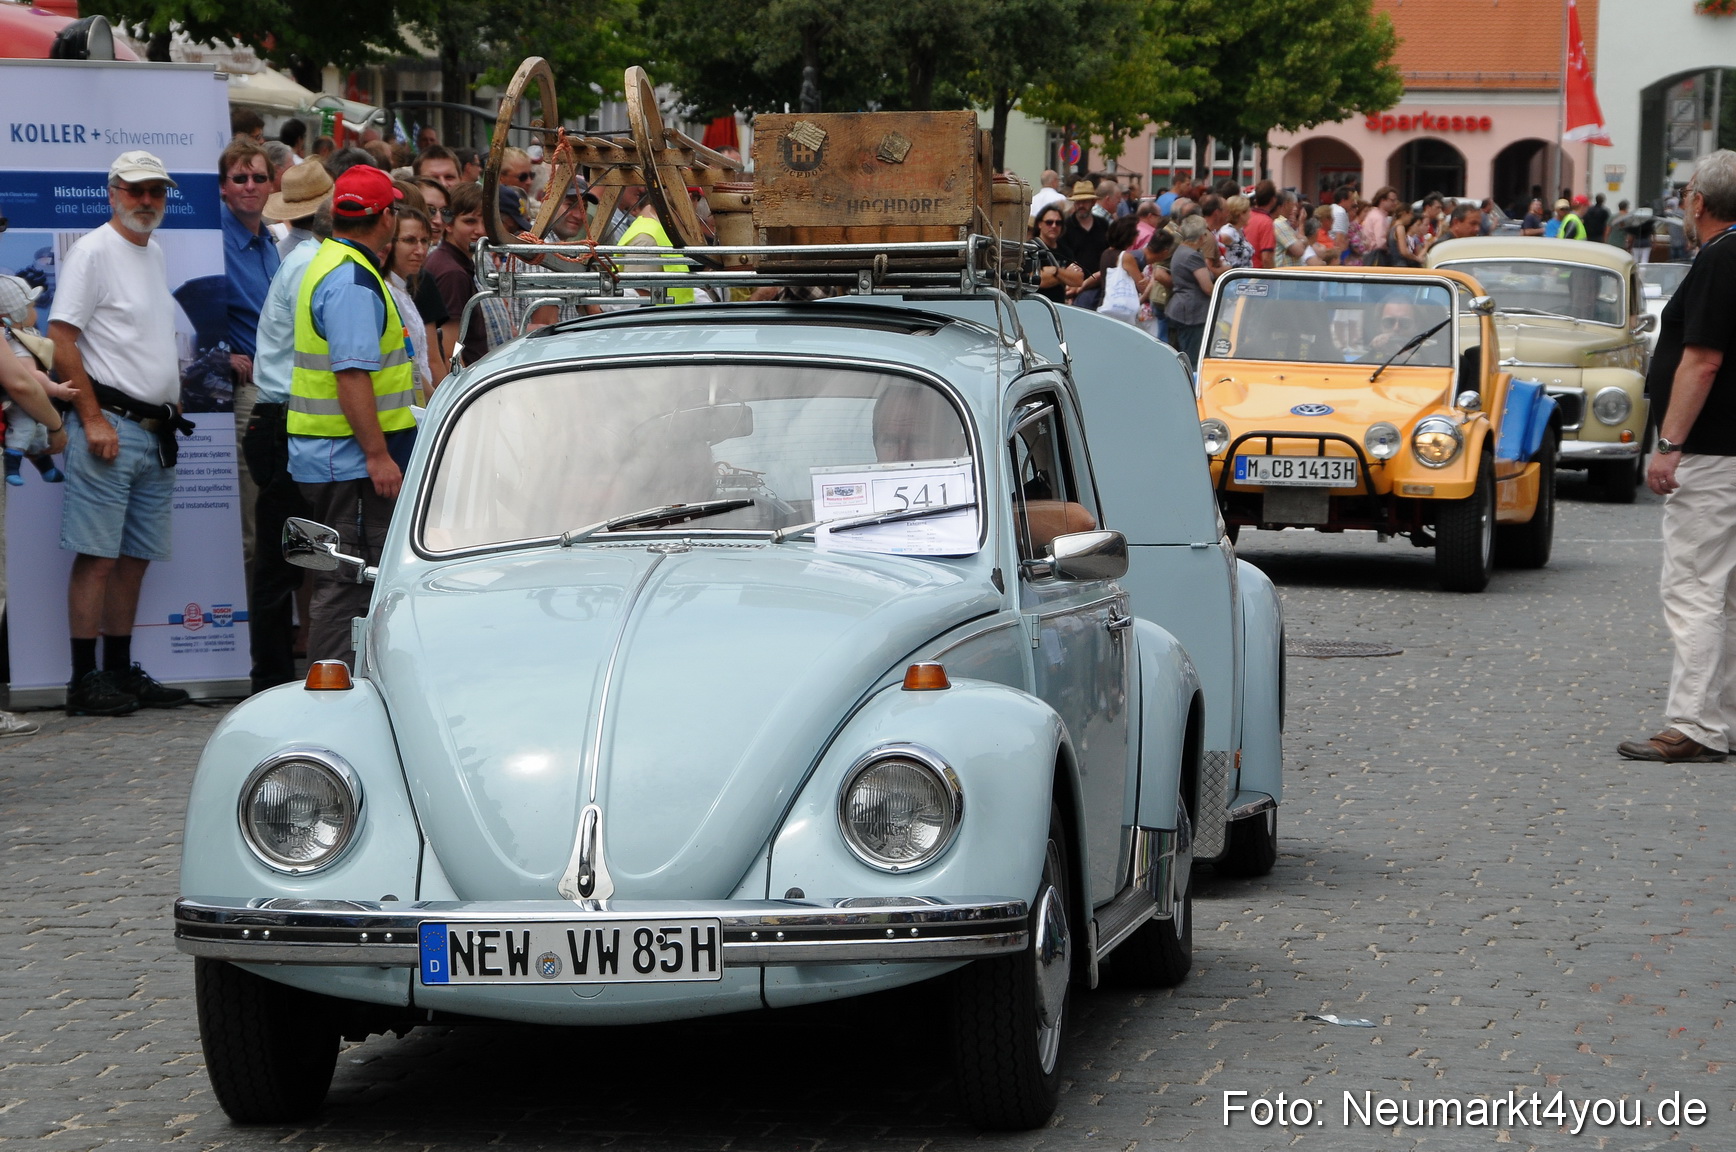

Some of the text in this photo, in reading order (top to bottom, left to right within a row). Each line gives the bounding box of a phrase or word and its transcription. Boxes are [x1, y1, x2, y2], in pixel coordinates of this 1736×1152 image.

[1365, 110, 1492, 135] Sparkasse
[10, 123, 86, 144] KOLLER
[104, 128, 195, 146] Schwemmer
[54, 186, 108, 198] Historisch
[55, 203, 78, 214] eine
[82, 203, 112, 214] Leiden
[846, 198, 943, 214] HOCHDORF
[1247, 459, 1259, 478] M
[1272, 460, 1294, 478] CB
[1298, 461, 1355, 480] 1413H
[894, 483, 948, 510] 541
[429, 926, 717, 976] D NEW VW 85H
